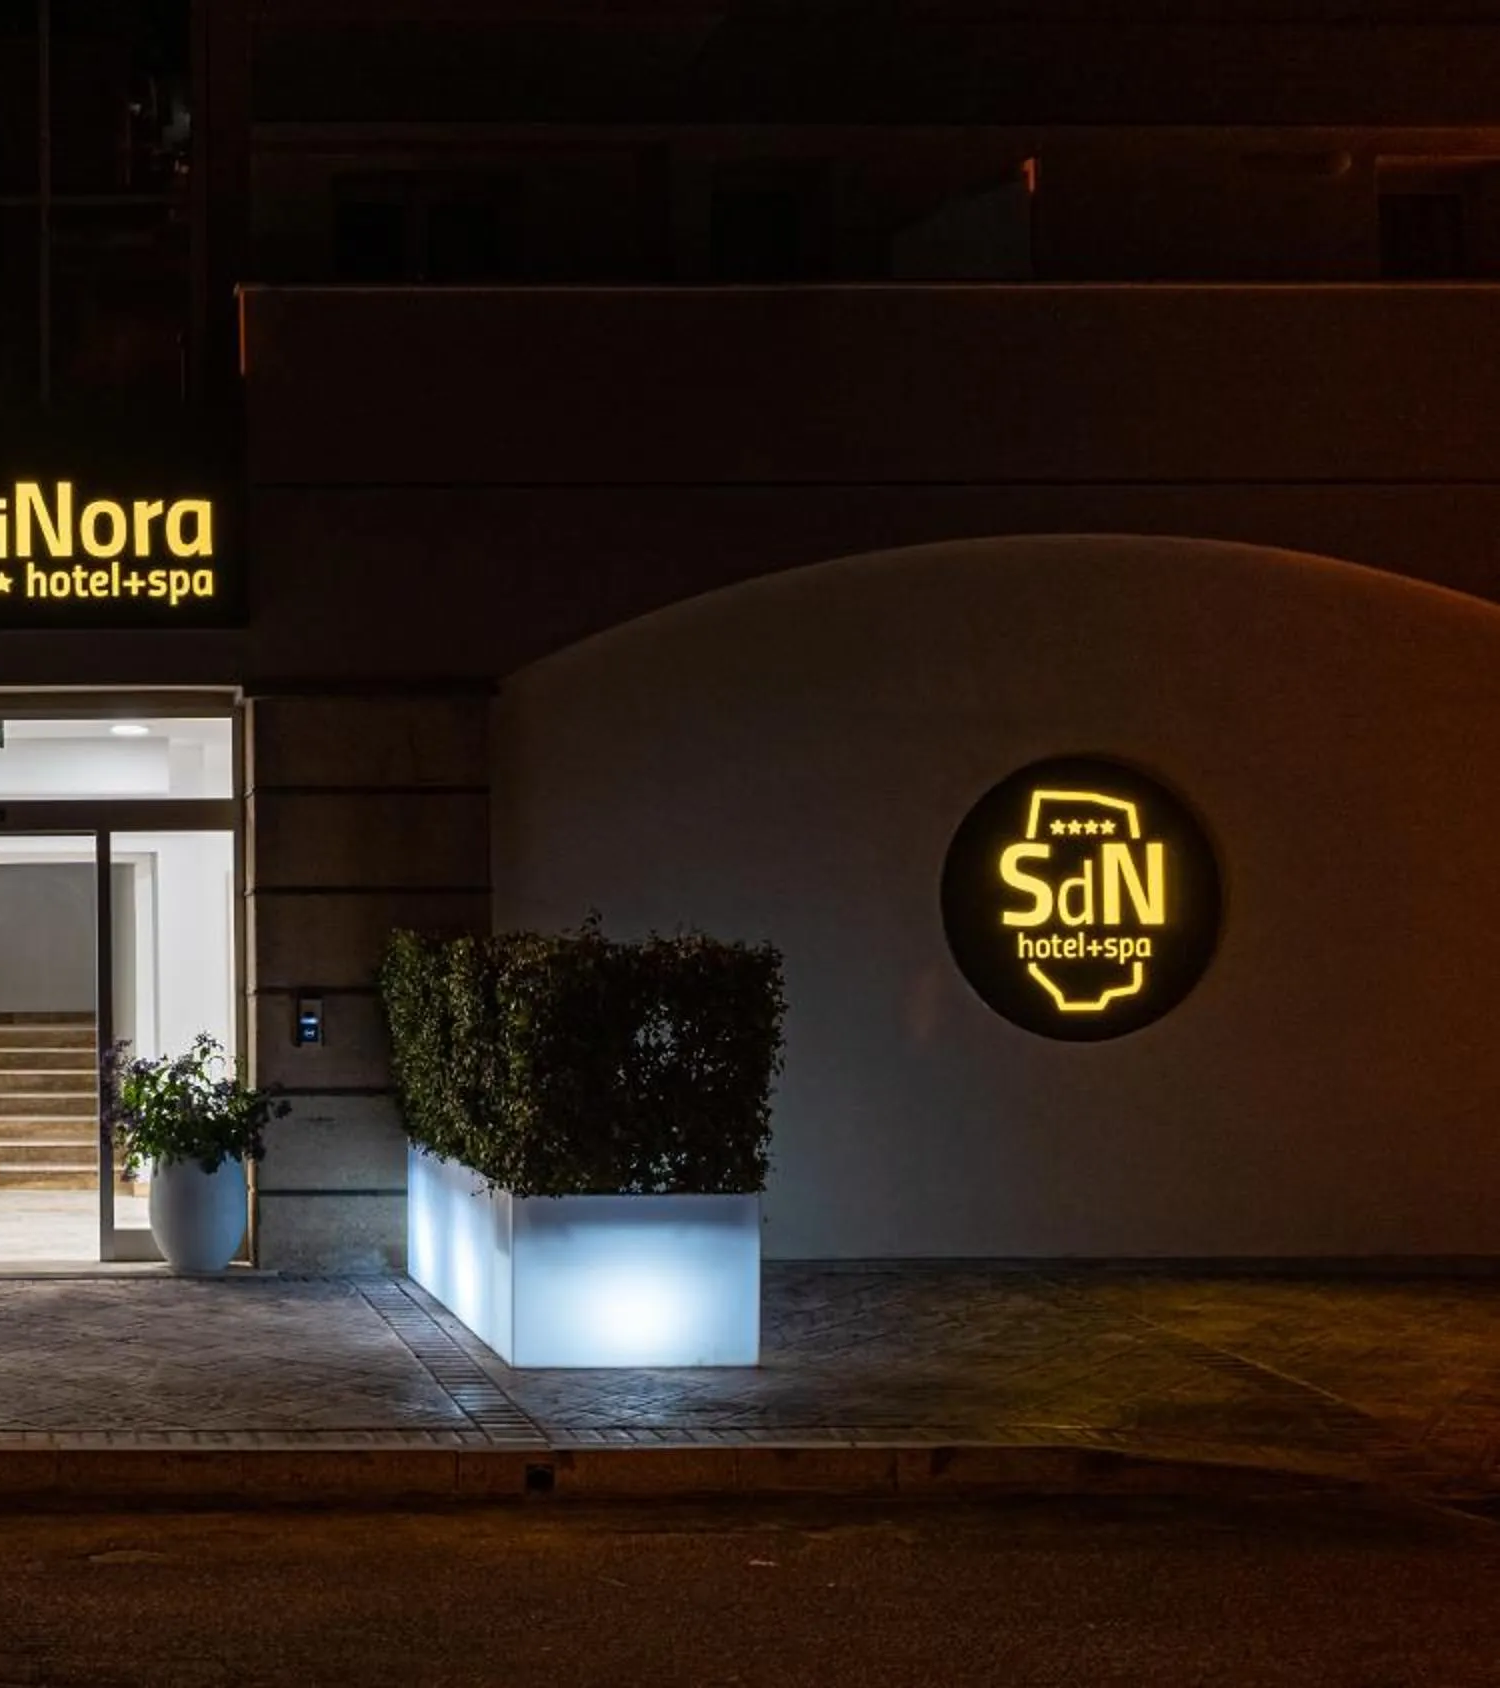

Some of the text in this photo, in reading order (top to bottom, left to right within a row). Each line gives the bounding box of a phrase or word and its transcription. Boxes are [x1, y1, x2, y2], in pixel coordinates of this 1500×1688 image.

[26, 561, 214, 606] hotel+spa
[999, 842, 1166, 928] SdN
[1017, 931, 1152, 965] hotel+spa
